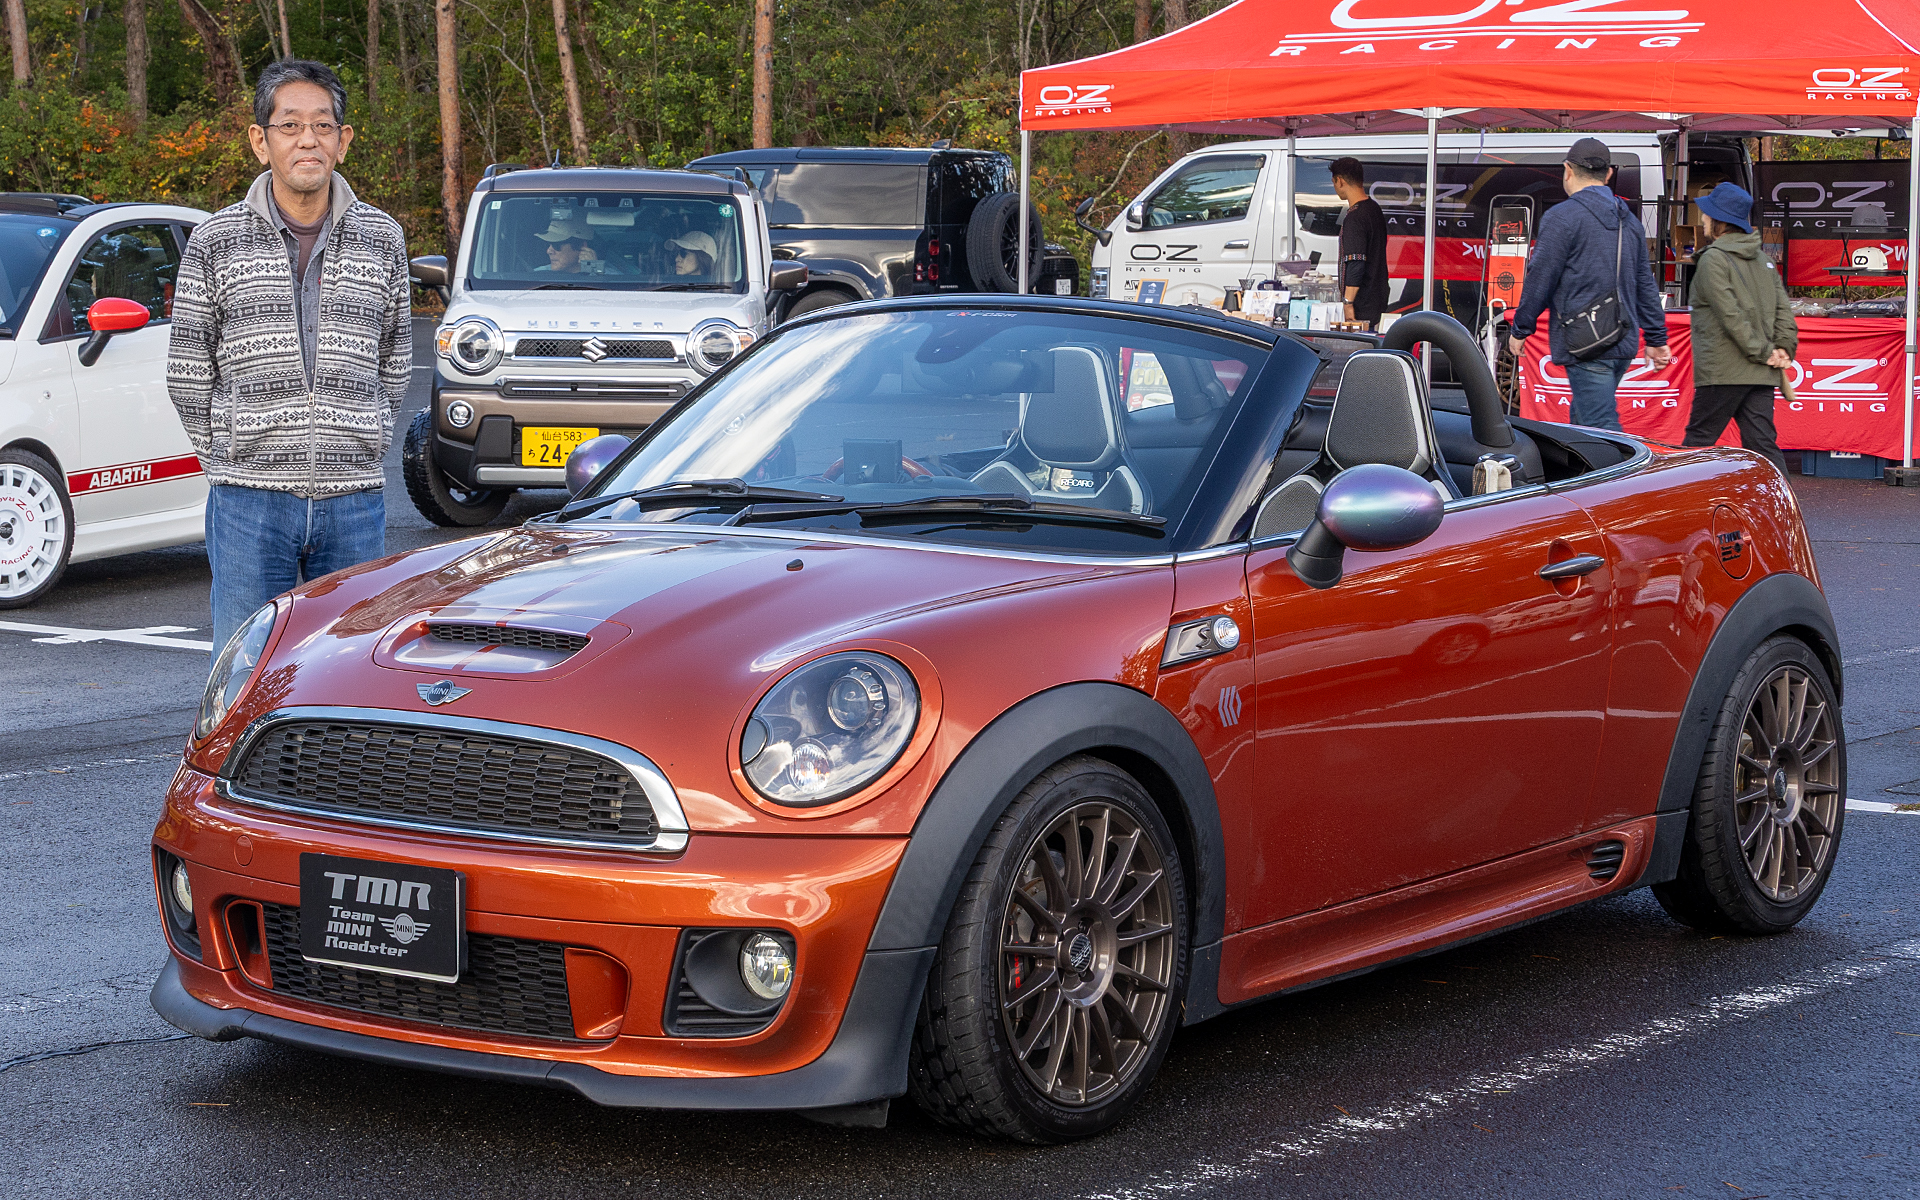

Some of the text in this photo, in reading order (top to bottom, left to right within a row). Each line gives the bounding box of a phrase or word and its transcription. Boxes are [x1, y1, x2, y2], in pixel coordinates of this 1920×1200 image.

[1269, 36, 1682, 57] RACING
[1806, 93, 1906, 101] RACING
[1034, 107, 1112, 117] RACING
[1387, 217, 1468, 228] ACNG
[1771, 220, 1841, 228] RACI
[527, 320, 664, 330] HUSTLER
[1535, 393, 1678, 408] RANG
[1789, 401, 1886, 412] CING
[541, 431, 583, 441] 仙台 583
[88, 464, 152, 489] ABARTH
[1060, 478, 1094, 488] RECARO
[1, 545, 34, 565] RACING
[430, 687, 450, 696] MINI
[323, 871, 432, 911] TMR
[329, 905, 376, 923] Team
[1166, 850, 1189, 990] BRIDGESTONE
[325, 920, 373, 938] MINI
[396, 924, 413, 934] MINI
[324, 935, 409, 958] Roadster
